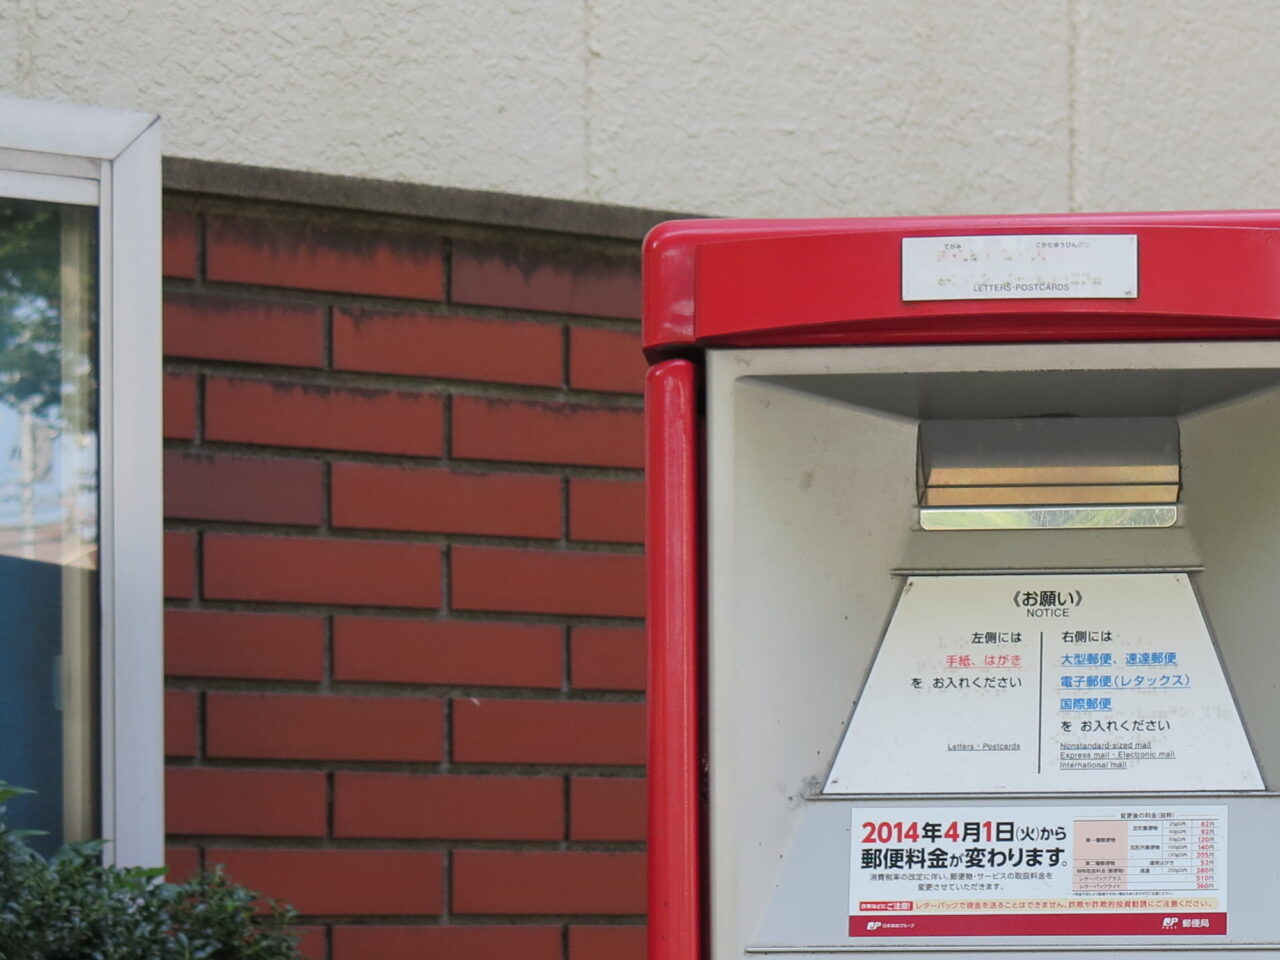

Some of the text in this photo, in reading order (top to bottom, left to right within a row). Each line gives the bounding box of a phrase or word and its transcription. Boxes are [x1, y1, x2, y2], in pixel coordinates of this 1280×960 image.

[1027, 608, 1070, 618] NOTICE
[971, 631, 1022, 644] 左側には
[1062, 630, 1112, 643] 右側には
[1060, 698, 1112, 710] 国際郵便
[1135, 741, 1152, 749] mail
[1060, 750, 1175, 760] Express mail Electronic mail
[1110, 761, 1127, 769] mail
[860, 847, 1068, 870] 郵便料金が変わります。
[918, 883, 1005, 892] 変更させていただきます。
[1182, 918, 1210, 929] 郵便局
